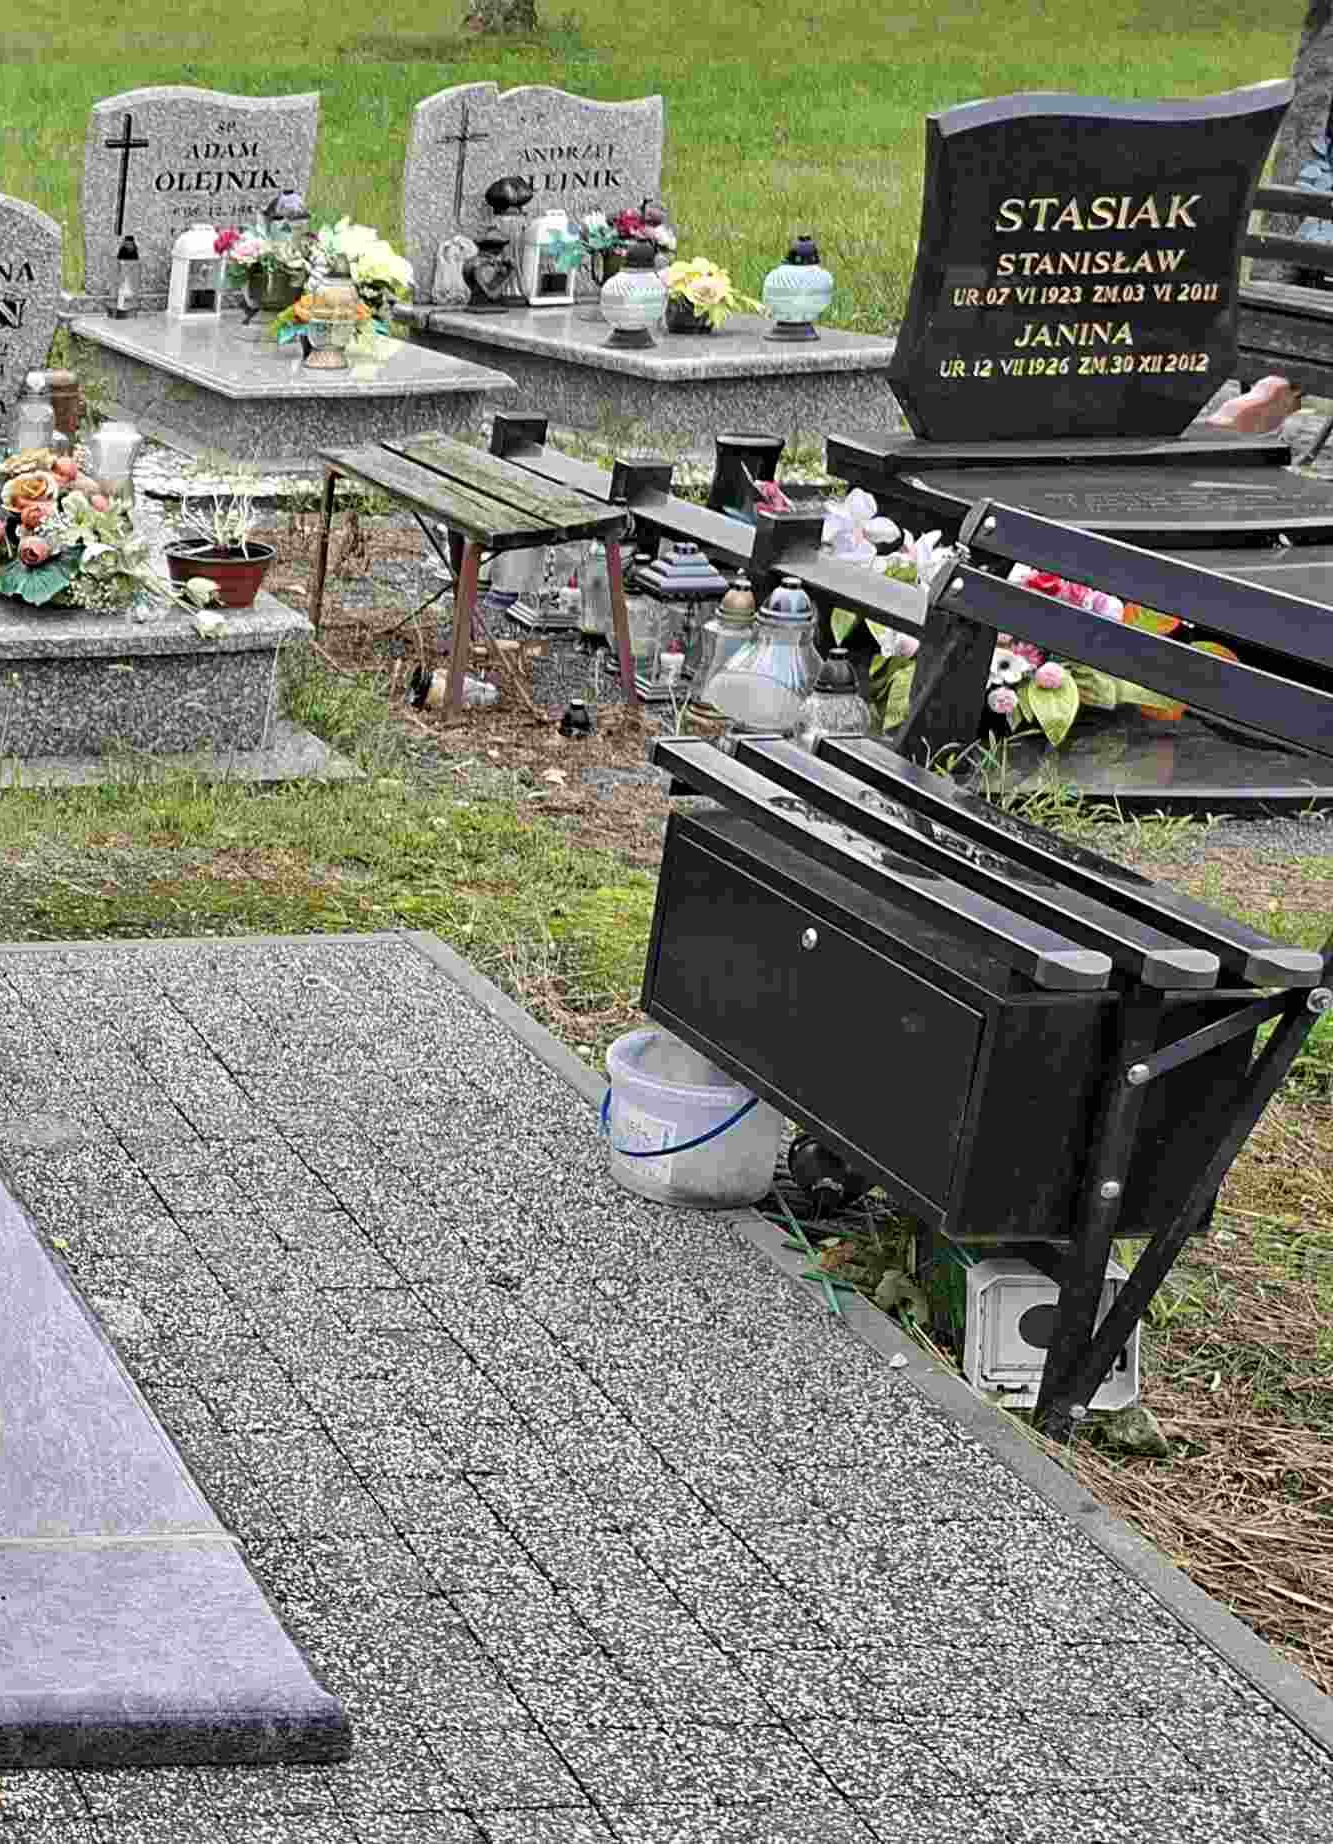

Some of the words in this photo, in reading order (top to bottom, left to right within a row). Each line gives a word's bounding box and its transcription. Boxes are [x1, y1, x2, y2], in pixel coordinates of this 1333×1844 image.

[185, 142, 259, 159] ADAM
[155, 169, 281, 196] OLEJNIK
[526, 168, 623, 192] LEJNIK
[995, 194, 1201, 232] STASIAK
[996, 250, 1185, 276] STANISŁAW
[1039, 286, 1082, 304] 1923
[1152, 284, 1173, 302] VI
[1176, 283, 1219, 302] 2011
[1014, 322, 1134, 348] JANINA
[1028, 357, 1070, 376] 1926
[1138, 354, 1162, 374] XII
[1166, 353, 1211, 374] 2012
